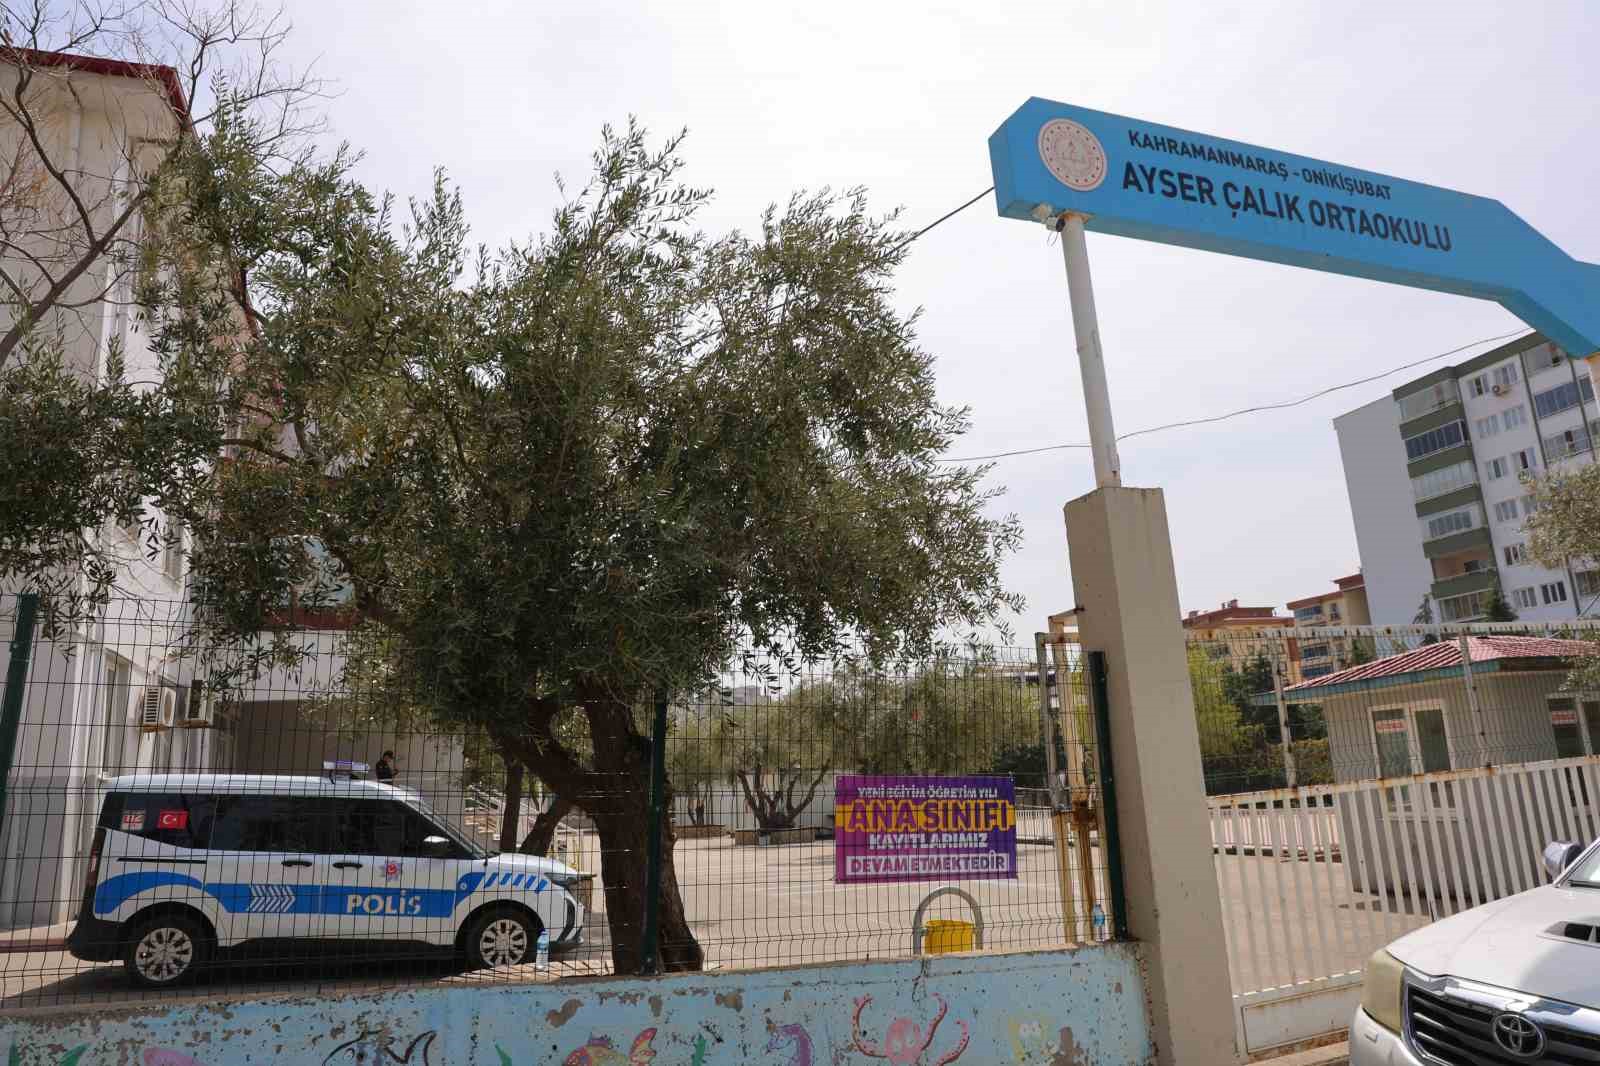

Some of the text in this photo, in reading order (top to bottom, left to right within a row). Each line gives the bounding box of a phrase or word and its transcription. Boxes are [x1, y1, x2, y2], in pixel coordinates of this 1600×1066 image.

[1127, 128, 1289, 182] KAHRAMANMARAŞ
[1302, 167, 1392, 200] ONİKİŞUBAT
[1122, 159, 1453, 252] AYSER ÇALIK ORTAOKULU
[927, 784, 977, 798] ÖĞRETİM
[846, 800, 1009, 832] ANA SINIFI
[869, 832, 989, 849] KAYITLARIMIZ
[850, 850, 1006, 873] DEVAM ETMEKTEDİR
[346, 889, 422, 915] POLİS
